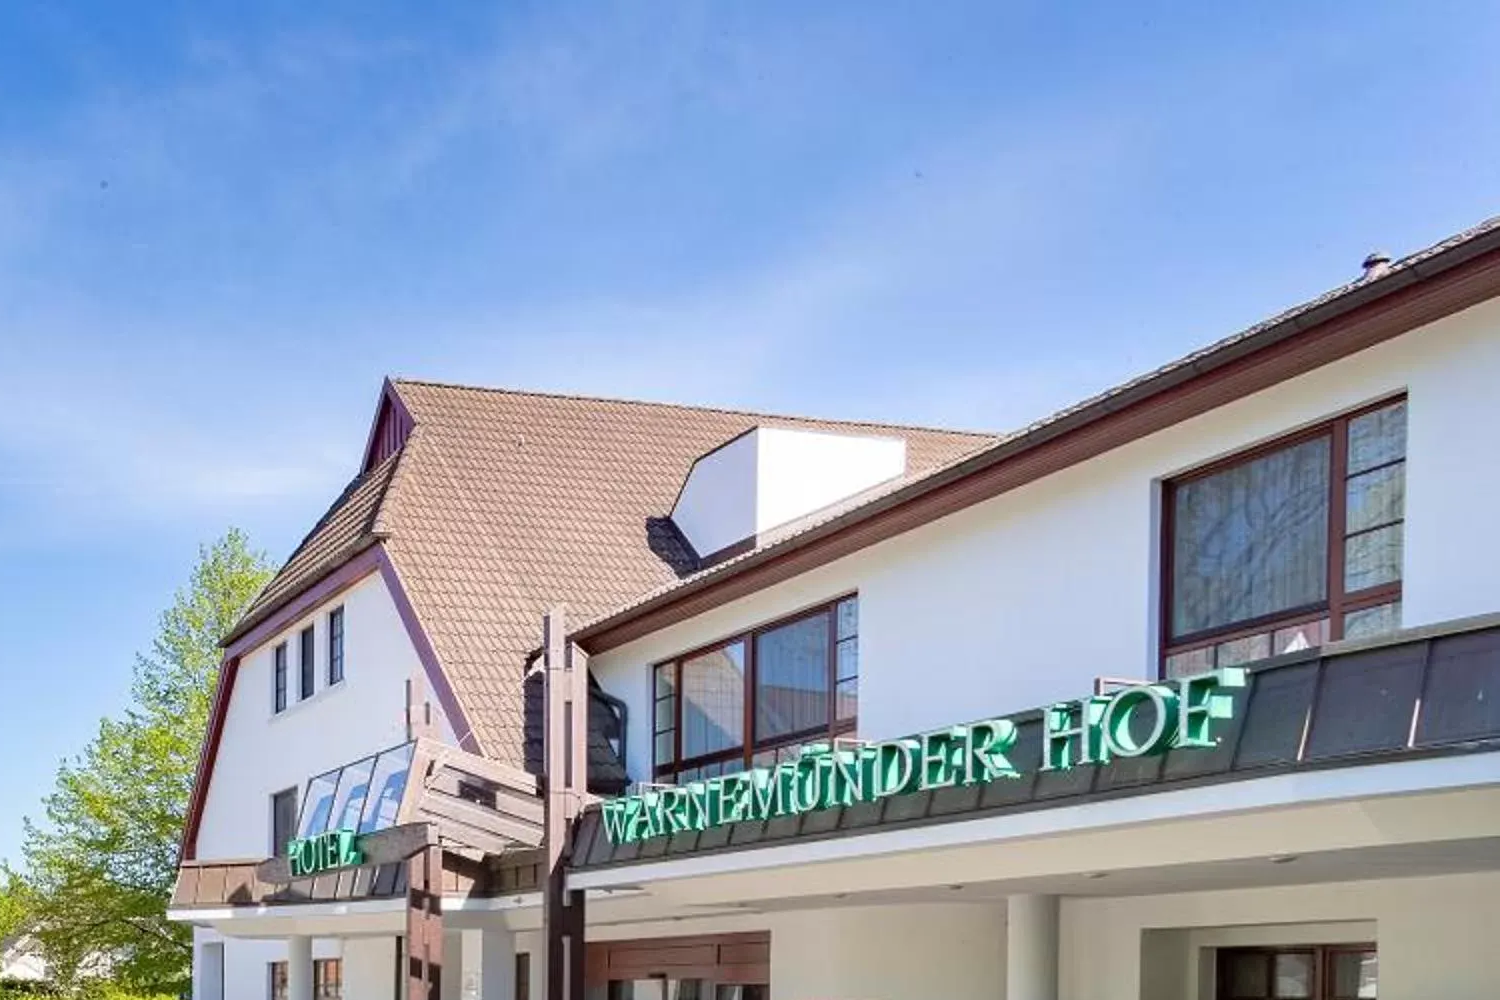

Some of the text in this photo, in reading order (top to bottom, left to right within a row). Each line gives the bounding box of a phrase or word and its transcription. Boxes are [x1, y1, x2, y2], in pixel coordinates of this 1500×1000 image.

[601, 667, 1249, 845] WARNEMÜNDER HOF
[287, 828, 360, 876] HOTEL
